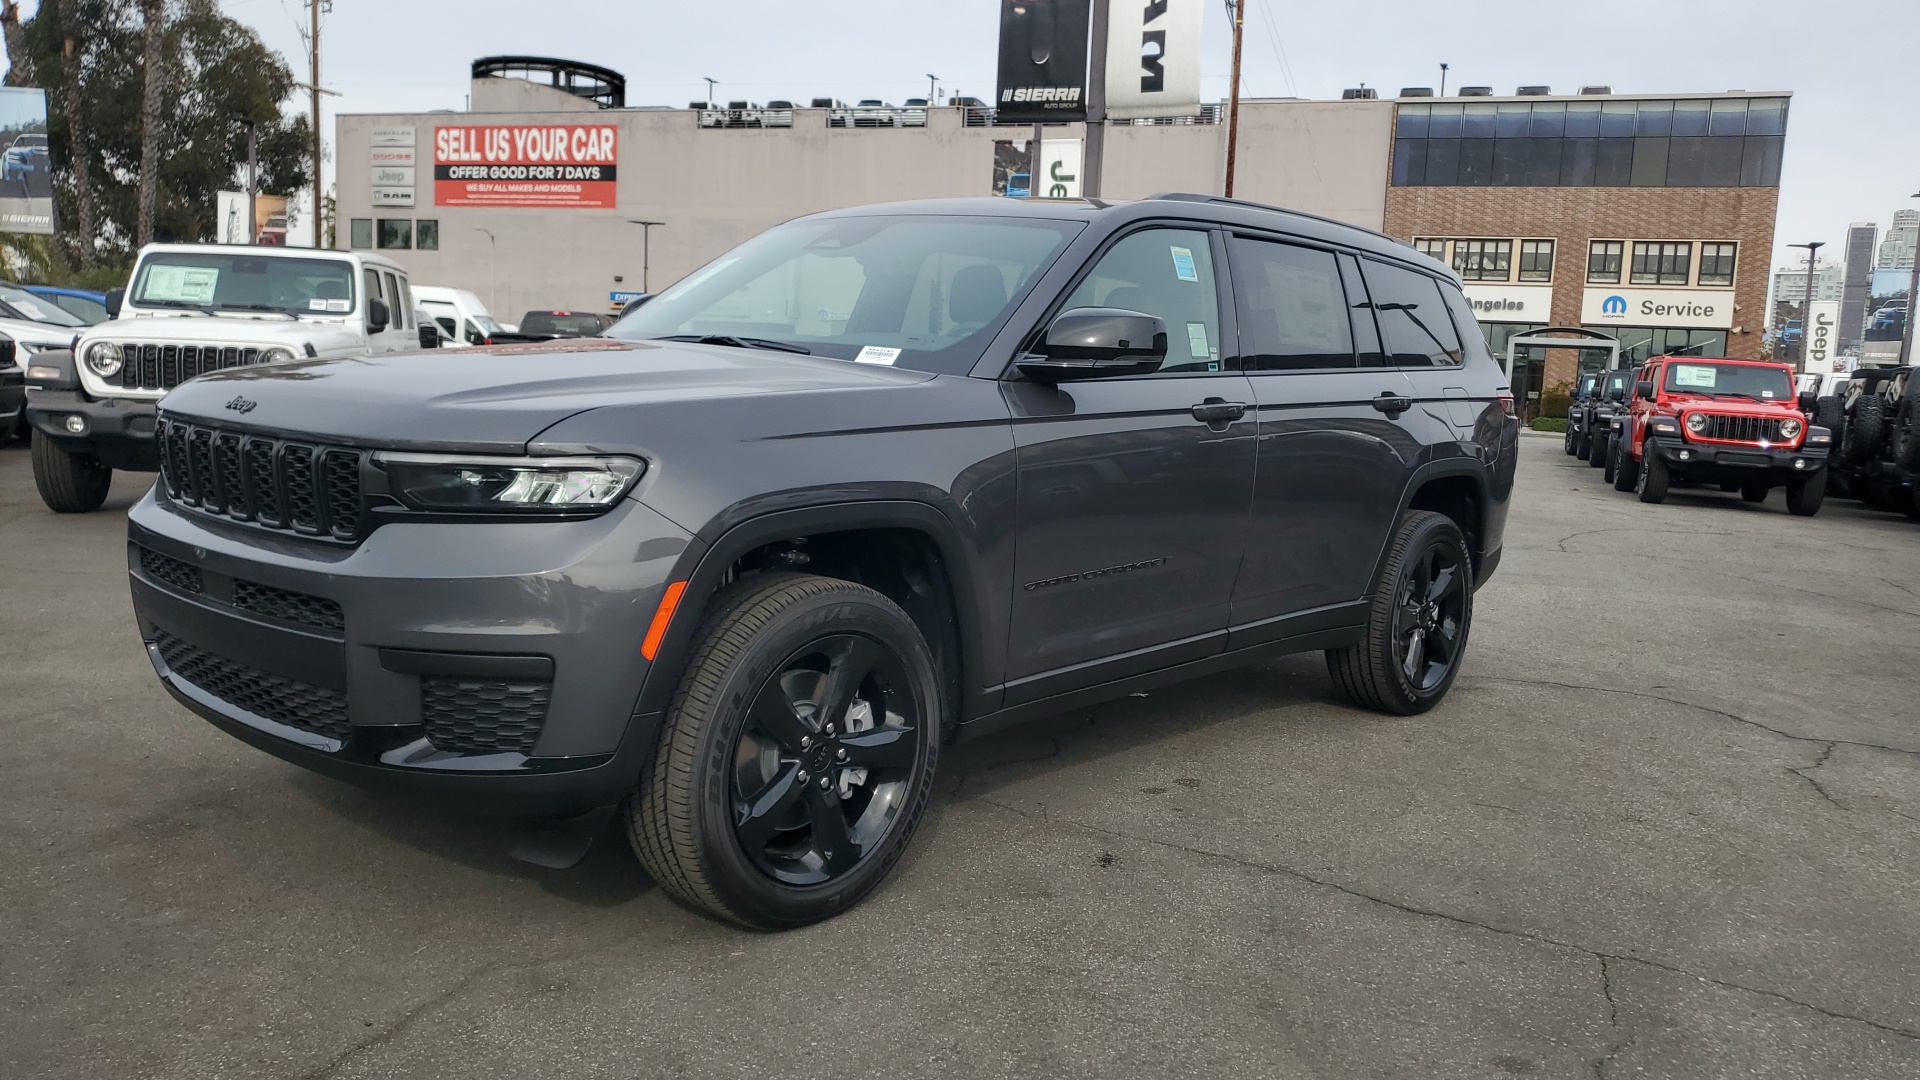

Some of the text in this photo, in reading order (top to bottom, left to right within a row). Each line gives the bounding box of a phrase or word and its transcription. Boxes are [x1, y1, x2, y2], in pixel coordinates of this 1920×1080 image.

[1013, 88, 1081, 102] SIERRA
[437, 127, 615, 161] SELL US YOUR CAR
[378, 170, 404, 183] Jeep
[449, 166, 600, 179] OFFER GOOD FOR 7 DAYS
[466, 183, 582, 192] WE BUY ALL MAKES AND MODELS
[1465, 297, 1525, 312] Angeles
[1640, 300, 1715, 317] Service
[1810, 313, 1833, 362] Jeep
[225, 395, 257, 414] Jeep
